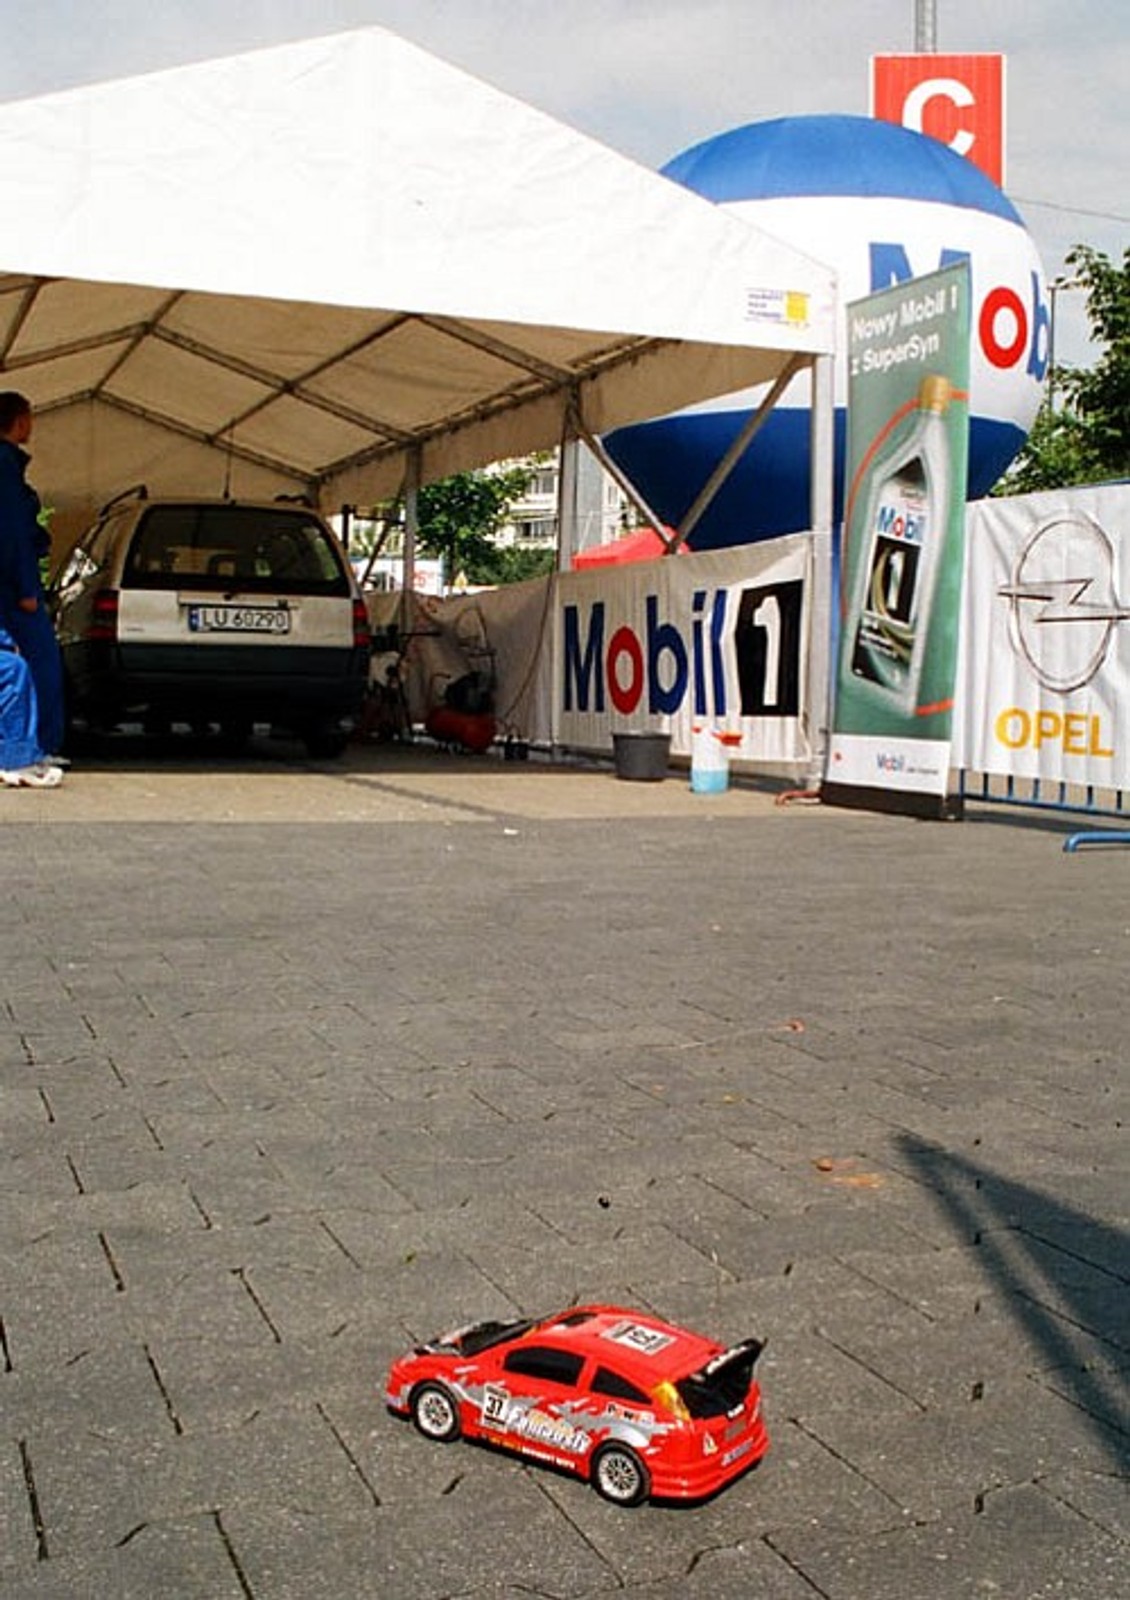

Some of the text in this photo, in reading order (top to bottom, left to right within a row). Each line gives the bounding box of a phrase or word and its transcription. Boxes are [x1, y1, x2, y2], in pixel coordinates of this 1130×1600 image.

[902, 78, 975, 156] C
[852, 308, 898, 343] Nowy
[901, 288, 946, 327] Mobil
[203, 610, 287, 629] LU 60290
[564, 588, 782, 716] Mobil 1
[994, 706, 1116, 758] OPEL
